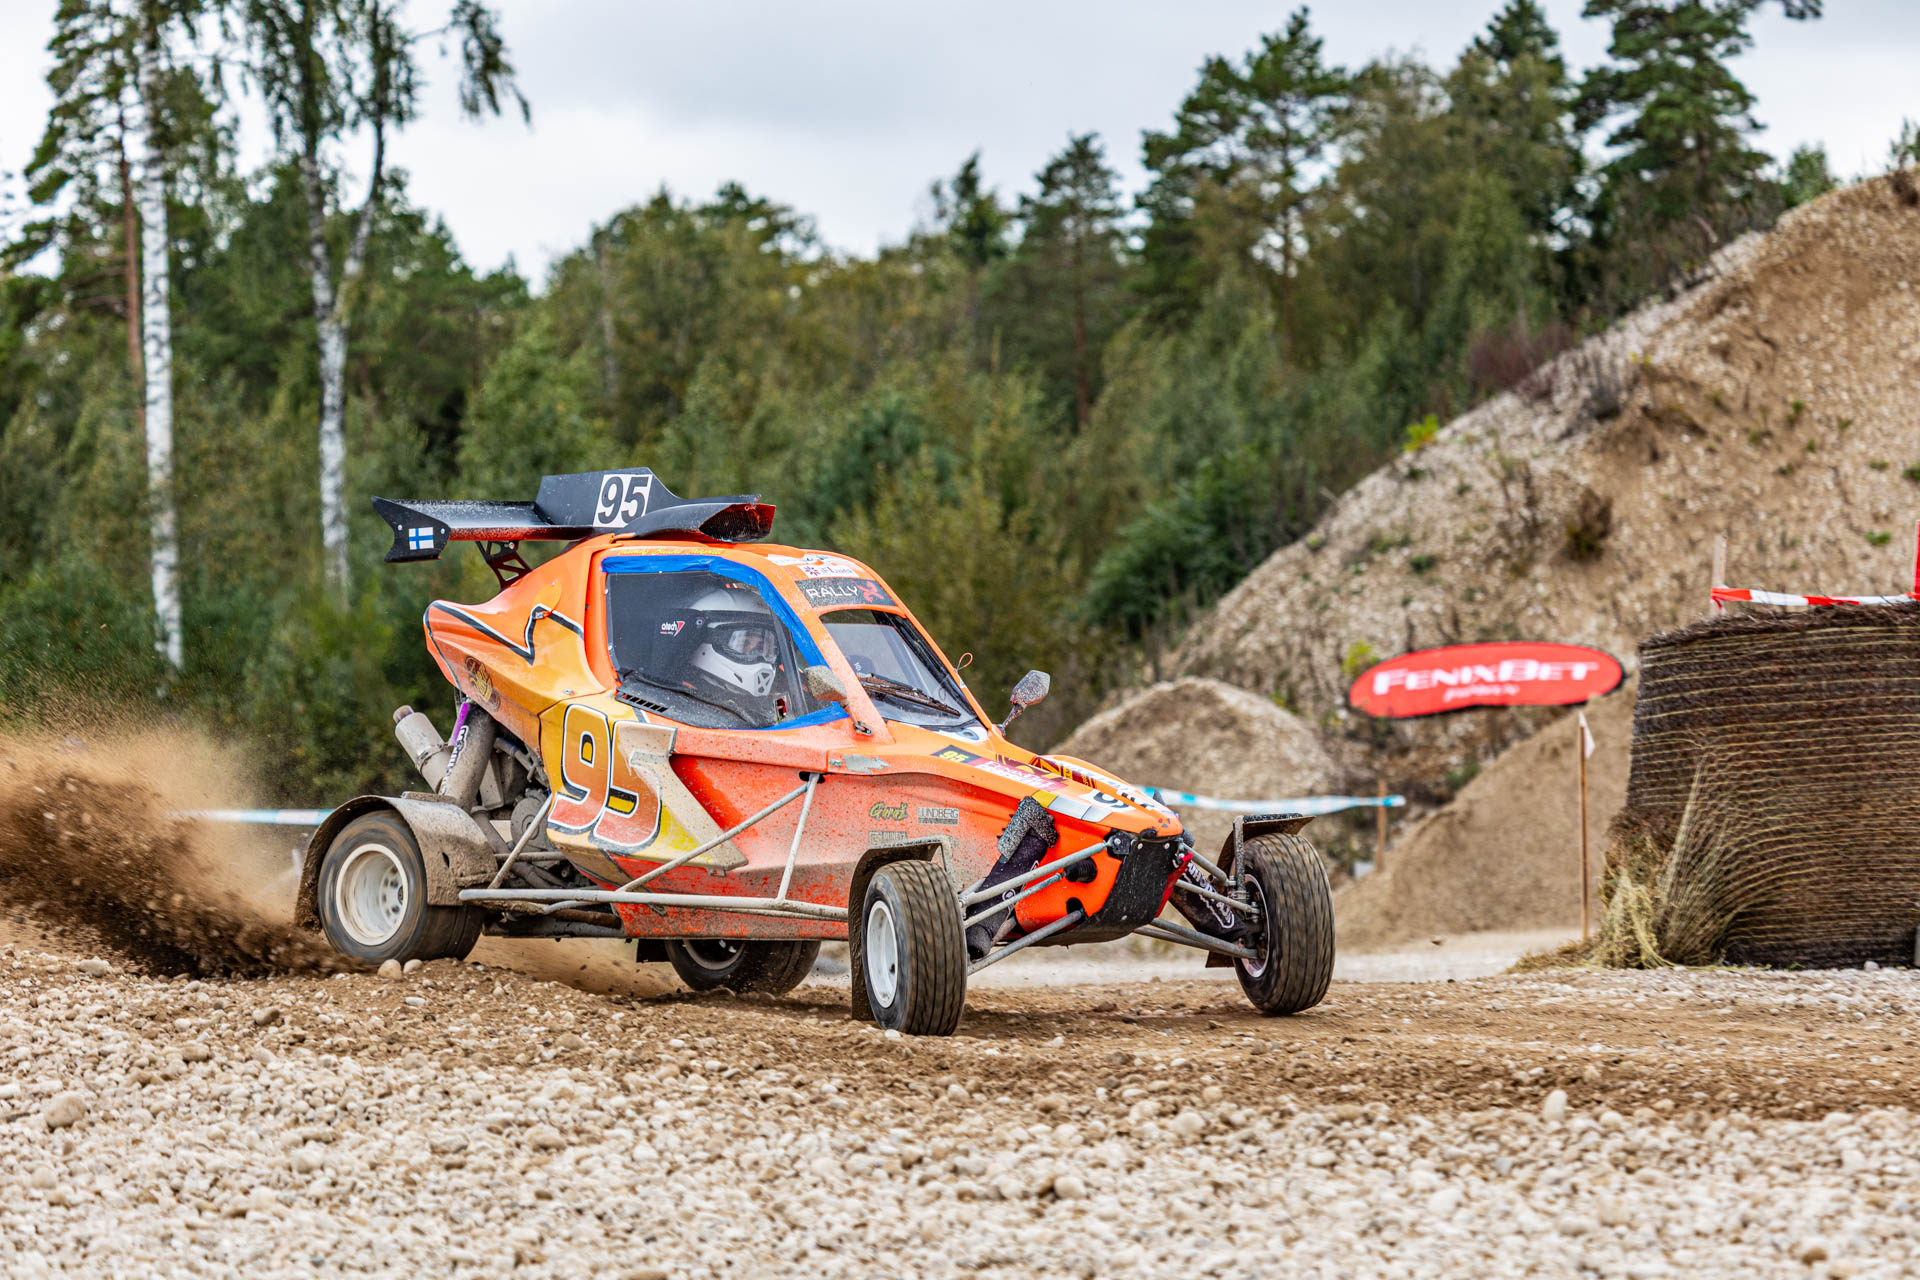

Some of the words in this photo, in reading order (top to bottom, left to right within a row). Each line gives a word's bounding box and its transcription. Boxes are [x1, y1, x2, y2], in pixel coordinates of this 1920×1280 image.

[597, 475, 649, 524] 95
[547, 704, 678, 848] 95
[939, 750, 969, 764] 95
